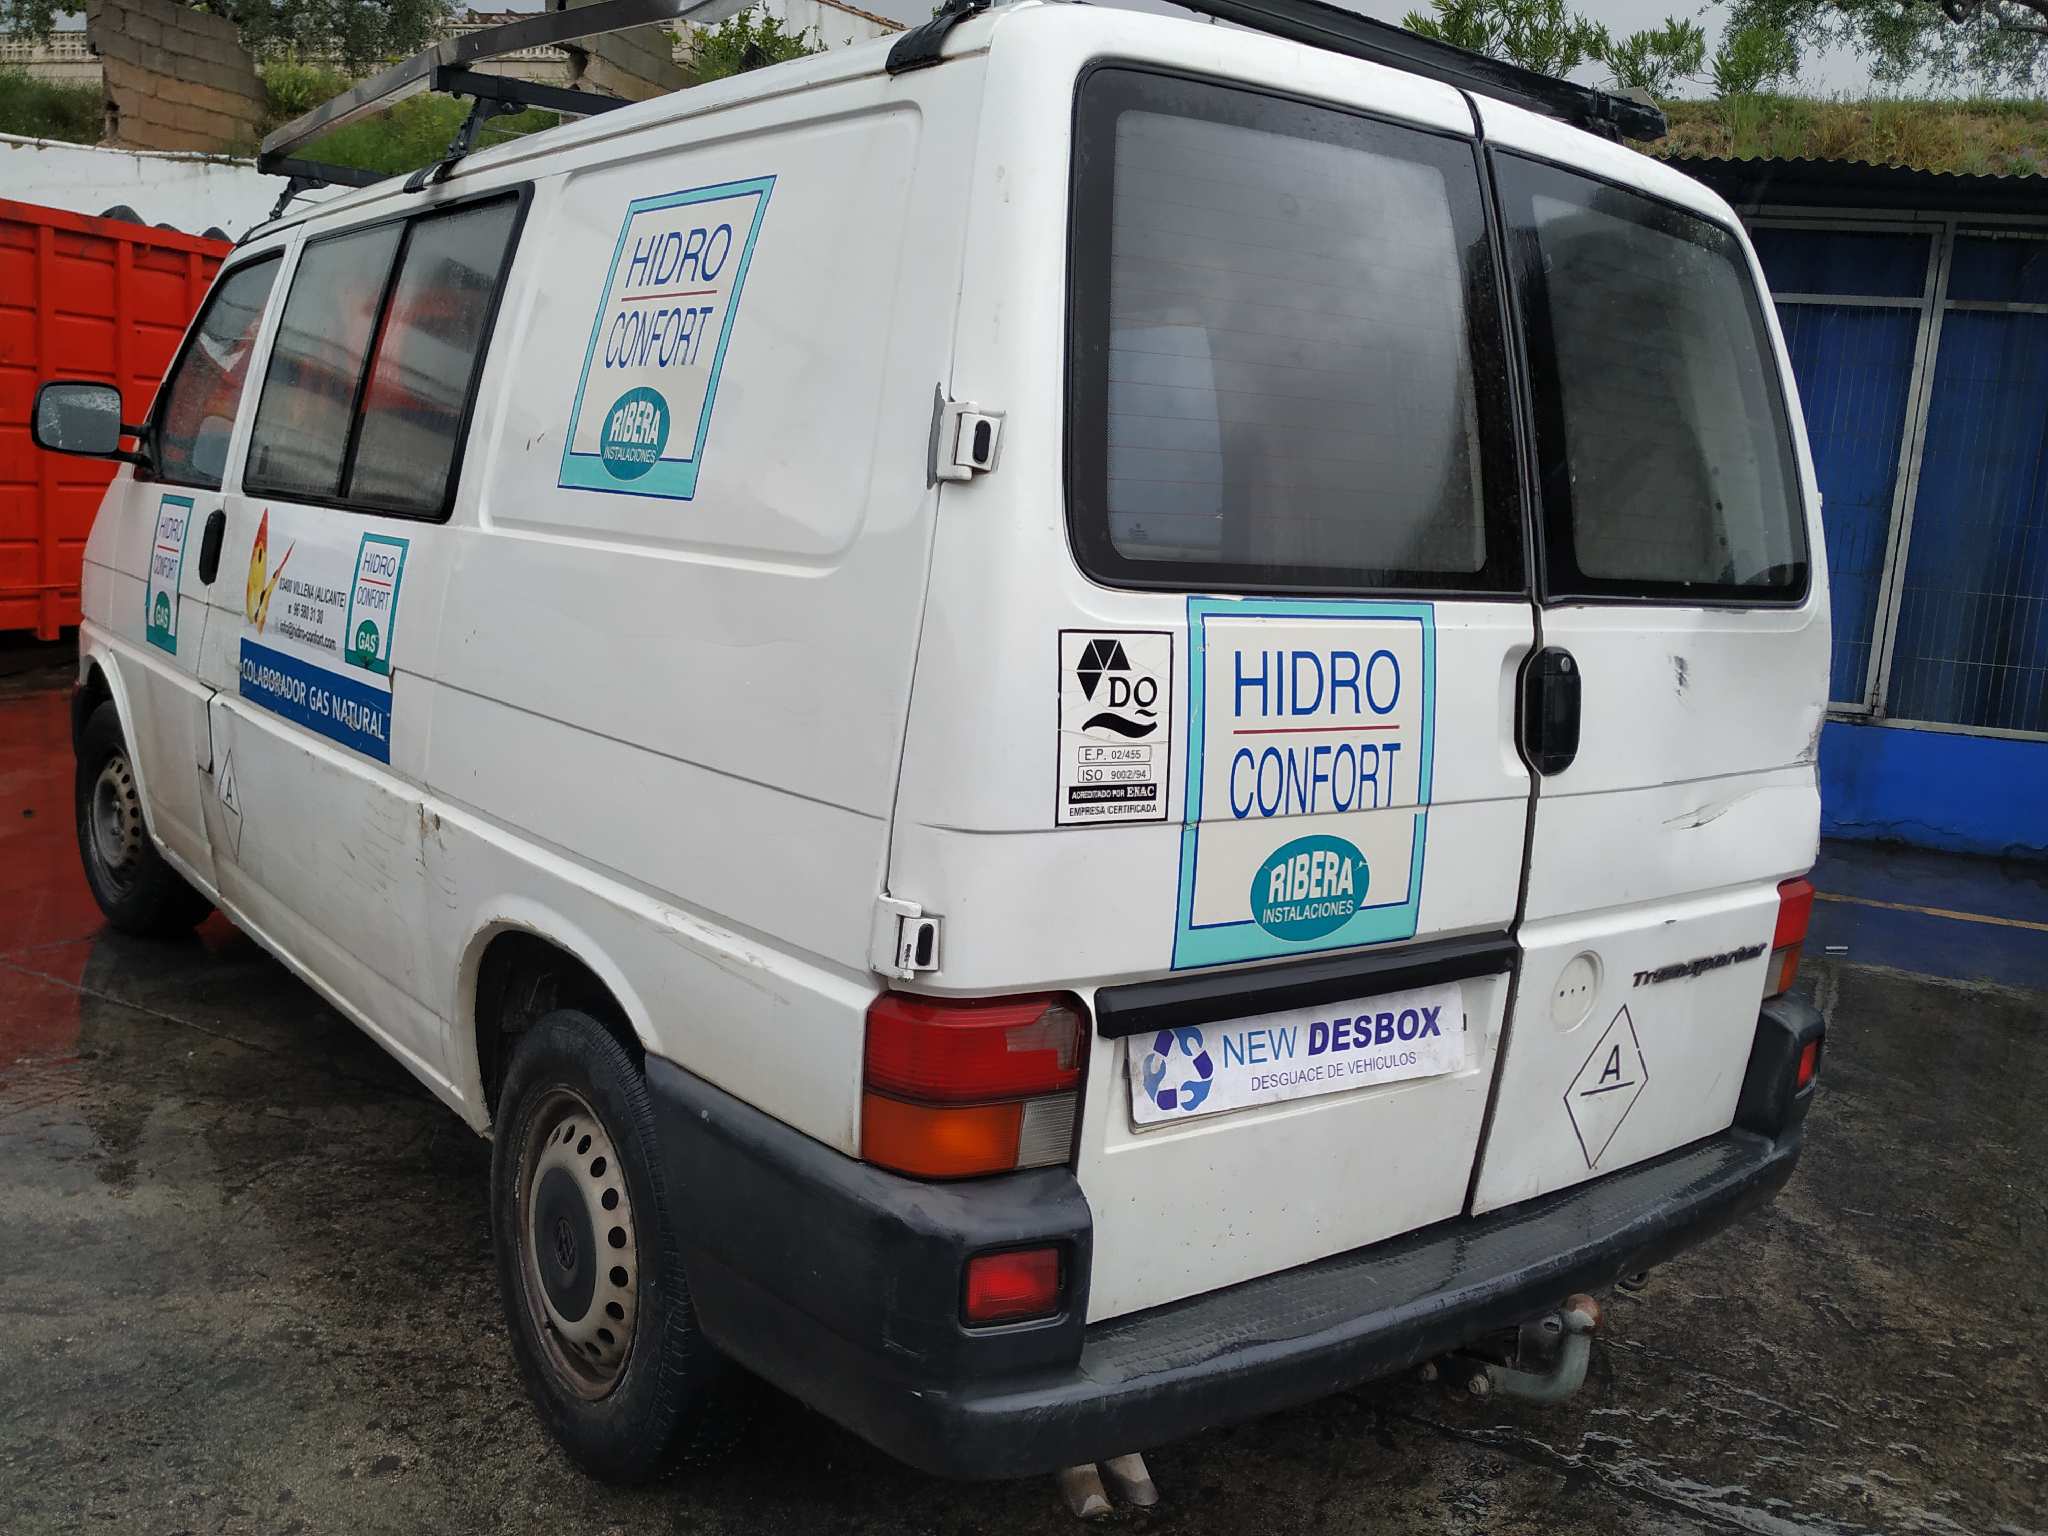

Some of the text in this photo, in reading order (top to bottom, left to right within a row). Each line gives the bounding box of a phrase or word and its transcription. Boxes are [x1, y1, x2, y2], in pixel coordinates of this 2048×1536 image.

[625, 223, 732, 288] HIDRO
[605, 306, 713, 368] CONFORT
[610, 400, 661, 445] RIBERA
[603, 446, 656, 464] INSTALACIONES
[160, 517, 184, 542] HIDRO
[153, 554, 178, 579] CONFORT
[362, 552, 396, 577] HIDRO
[293, 580, 315, 599] VILLENA
[357, 586, 390, 611] CONFORT
[156, 604, 169, 628] GAS
[358, 631, 377, 653] GAS
[1234, 649, 1401, 717] HIDRO
[242, 658, 385, 740] COLABORADOR GAS NATURAL
[1084, 748, 1107, 761] E.P.
[1082, 769, 1103, 781] ISO
[1230, 742, 1401, 820] CONFORT
[1071, 785, 1155, 800] ACREDITADO POR ENAC
[1069, 804, 1157, 817] EMPRESA CERTIFICADA
[1268, 850, 1354, 904] RIBERA
[1262, 899, 1354, 925] INSTALACIONES
[1223, 1006, 1442, 1069] NEW DESBOX
[1251, 1051, 1417, 1092] DESGUACE DE VEHICULOS
[1598, 1044, 1620, 1084] A
